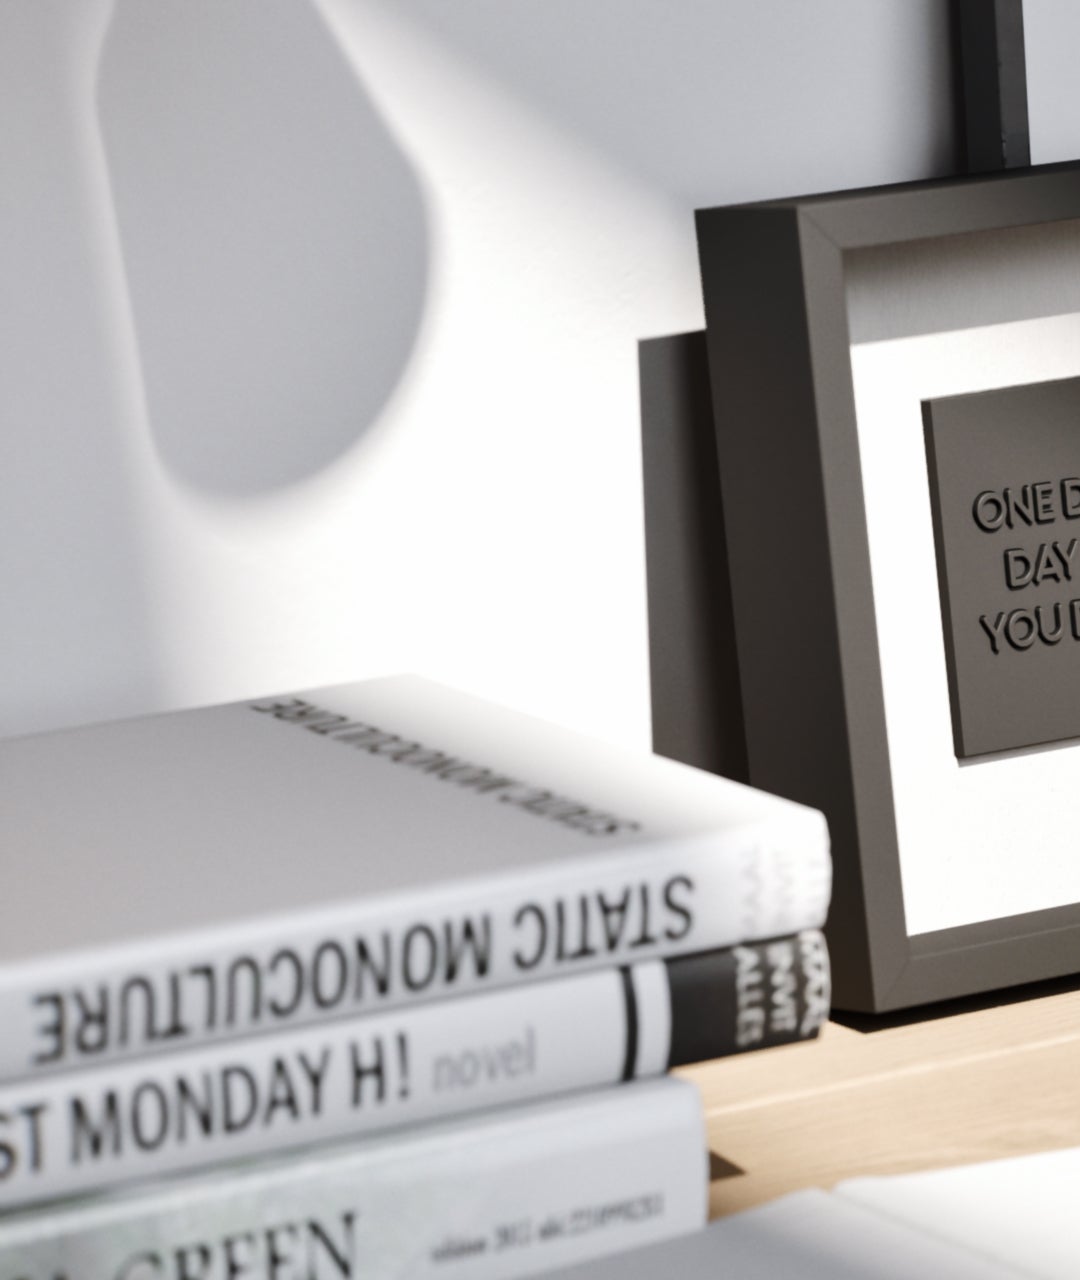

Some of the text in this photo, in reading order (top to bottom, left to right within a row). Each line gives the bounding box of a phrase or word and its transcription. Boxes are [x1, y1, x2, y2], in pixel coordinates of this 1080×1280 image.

[972, 481, 1055, 534] ONE
[1003, 538, 1078, 591] DAY
[979, 602, 1063, 655] YOU
[513, 873, 696, 972] STATIC
[32, 913, 491, 1066] MONOCULTURE
[69, 1045, 332, 1165] MONDAY
[432, 1027, 538, 1093] novel
